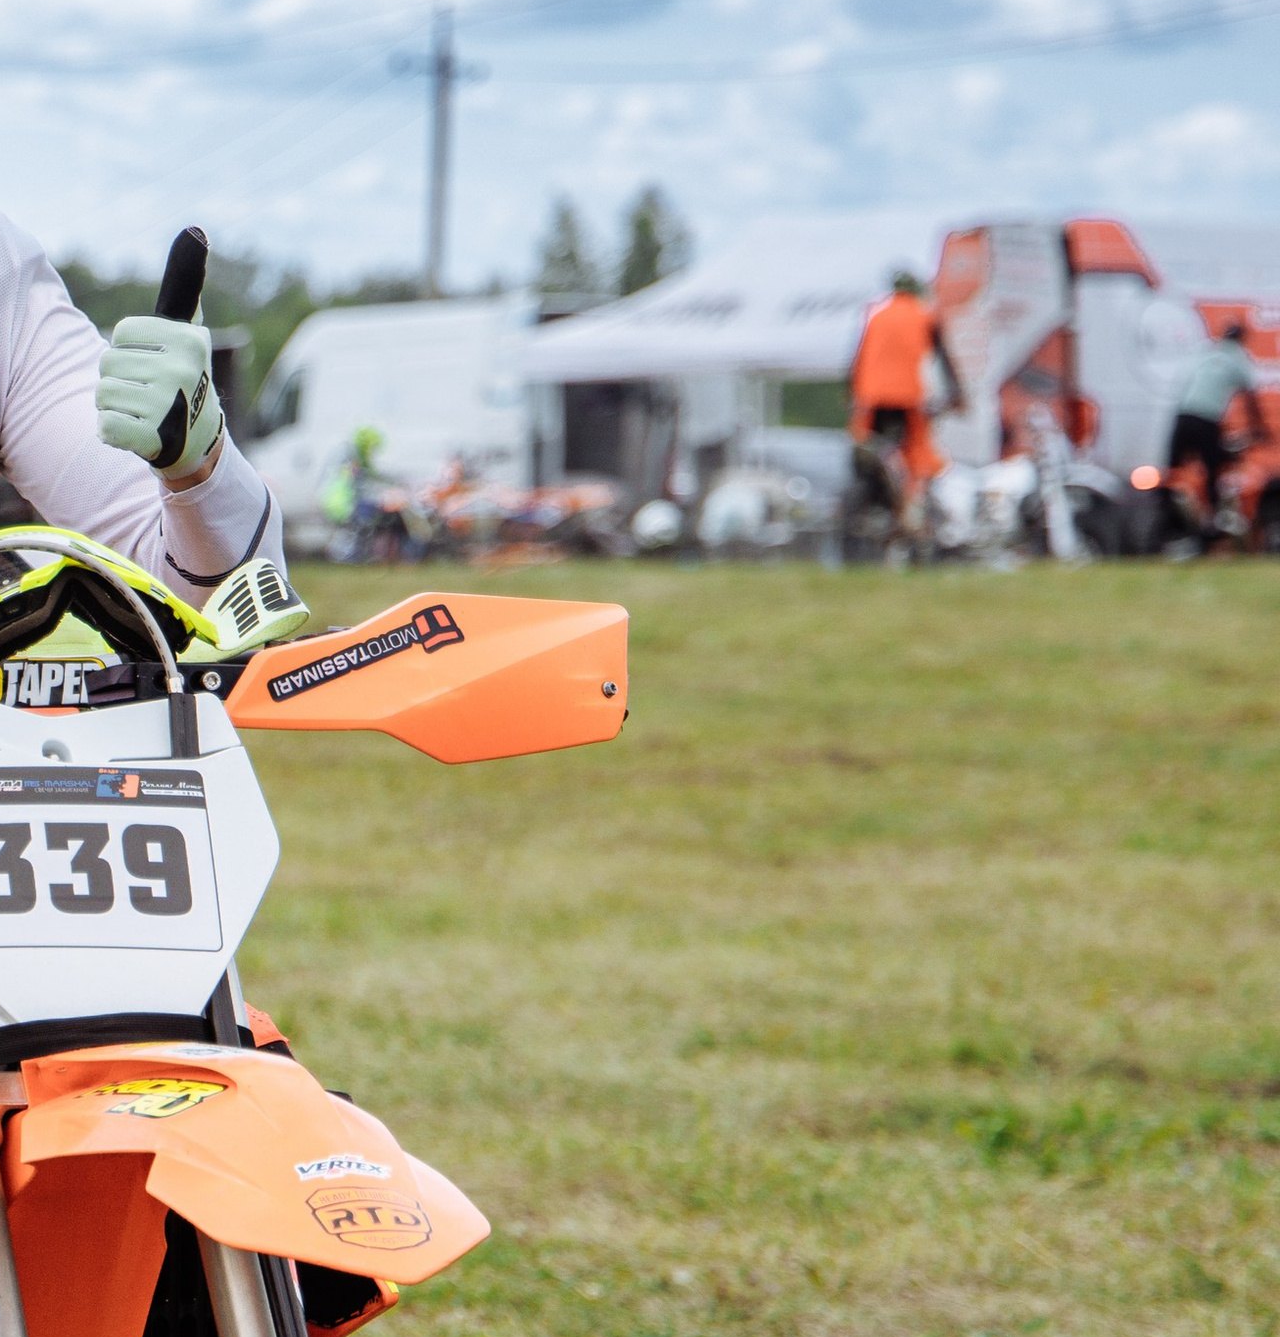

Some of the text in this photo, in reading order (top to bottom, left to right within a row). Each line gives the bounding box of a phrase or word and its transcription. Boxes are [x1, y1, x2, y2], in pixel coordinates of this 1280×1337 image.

[272, 626, 419, 697] MOTOTASSINARI
[297, 1160, 382, 1174] VERTEX
[325, 1207, 421, 1229] RTD
